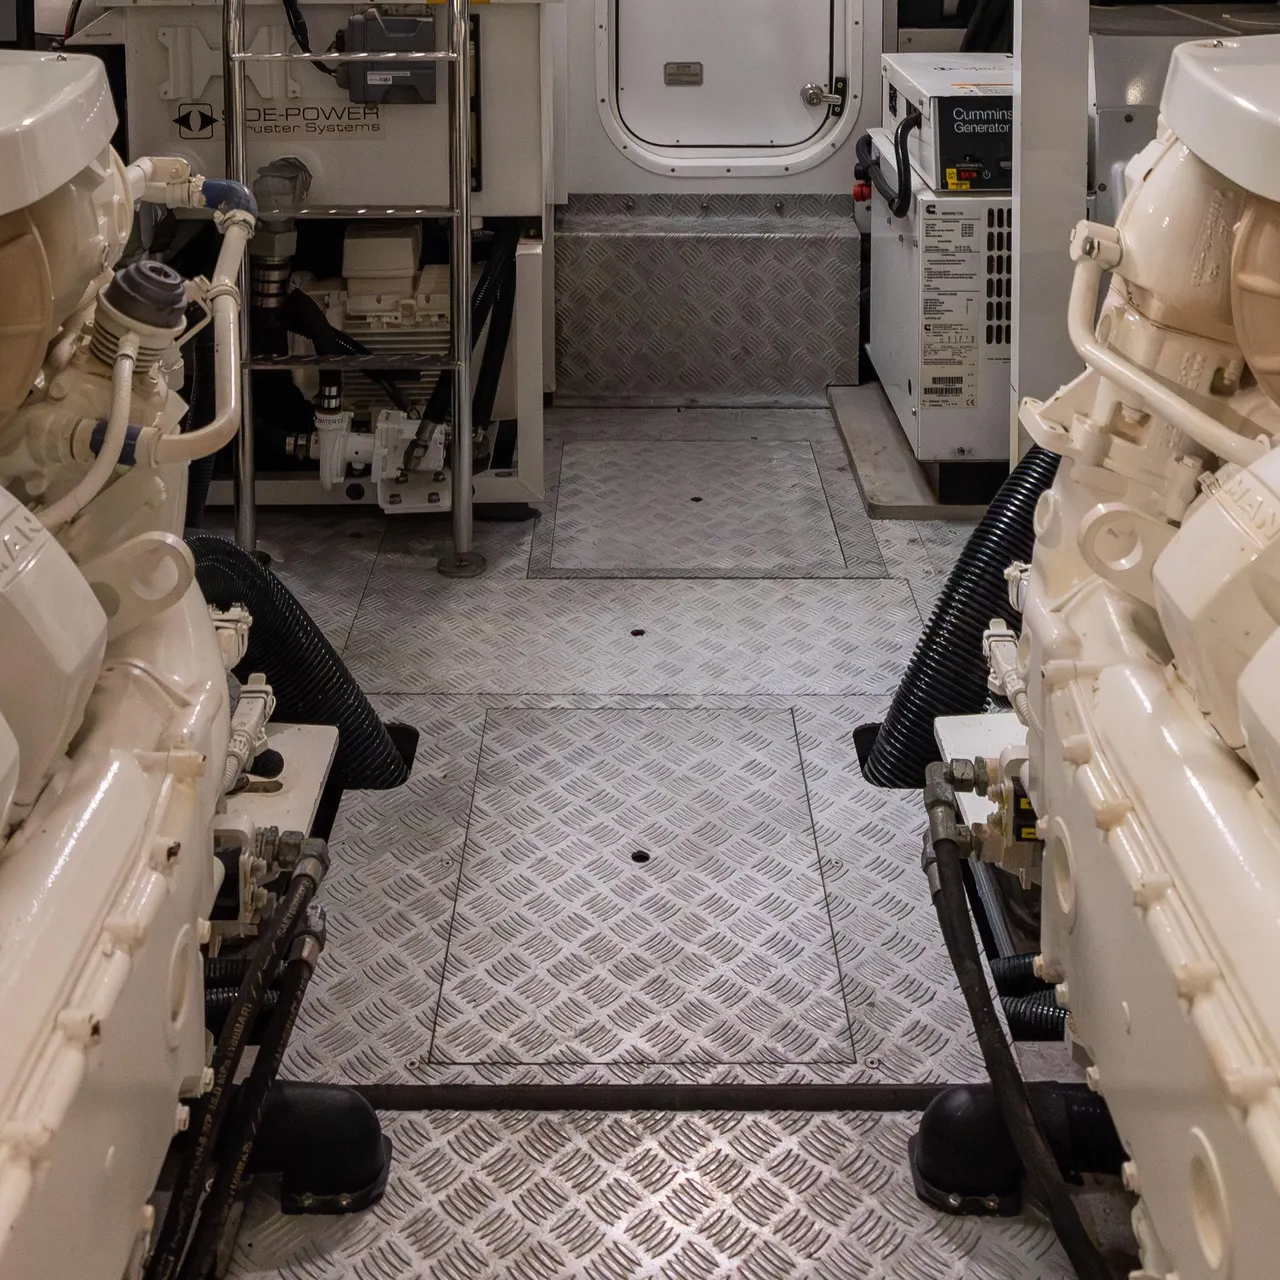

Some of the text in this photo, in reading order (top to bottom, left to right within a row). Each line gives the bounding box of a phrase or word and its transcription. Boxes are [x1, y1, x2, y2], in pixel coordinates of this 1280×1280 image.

[221, 107, 379, 122] DE-POWER
[953, 107, 1013, 120] Cummins
[305, 122, 380, 135] Systems
[954, 122, 1010, 133] Generator
